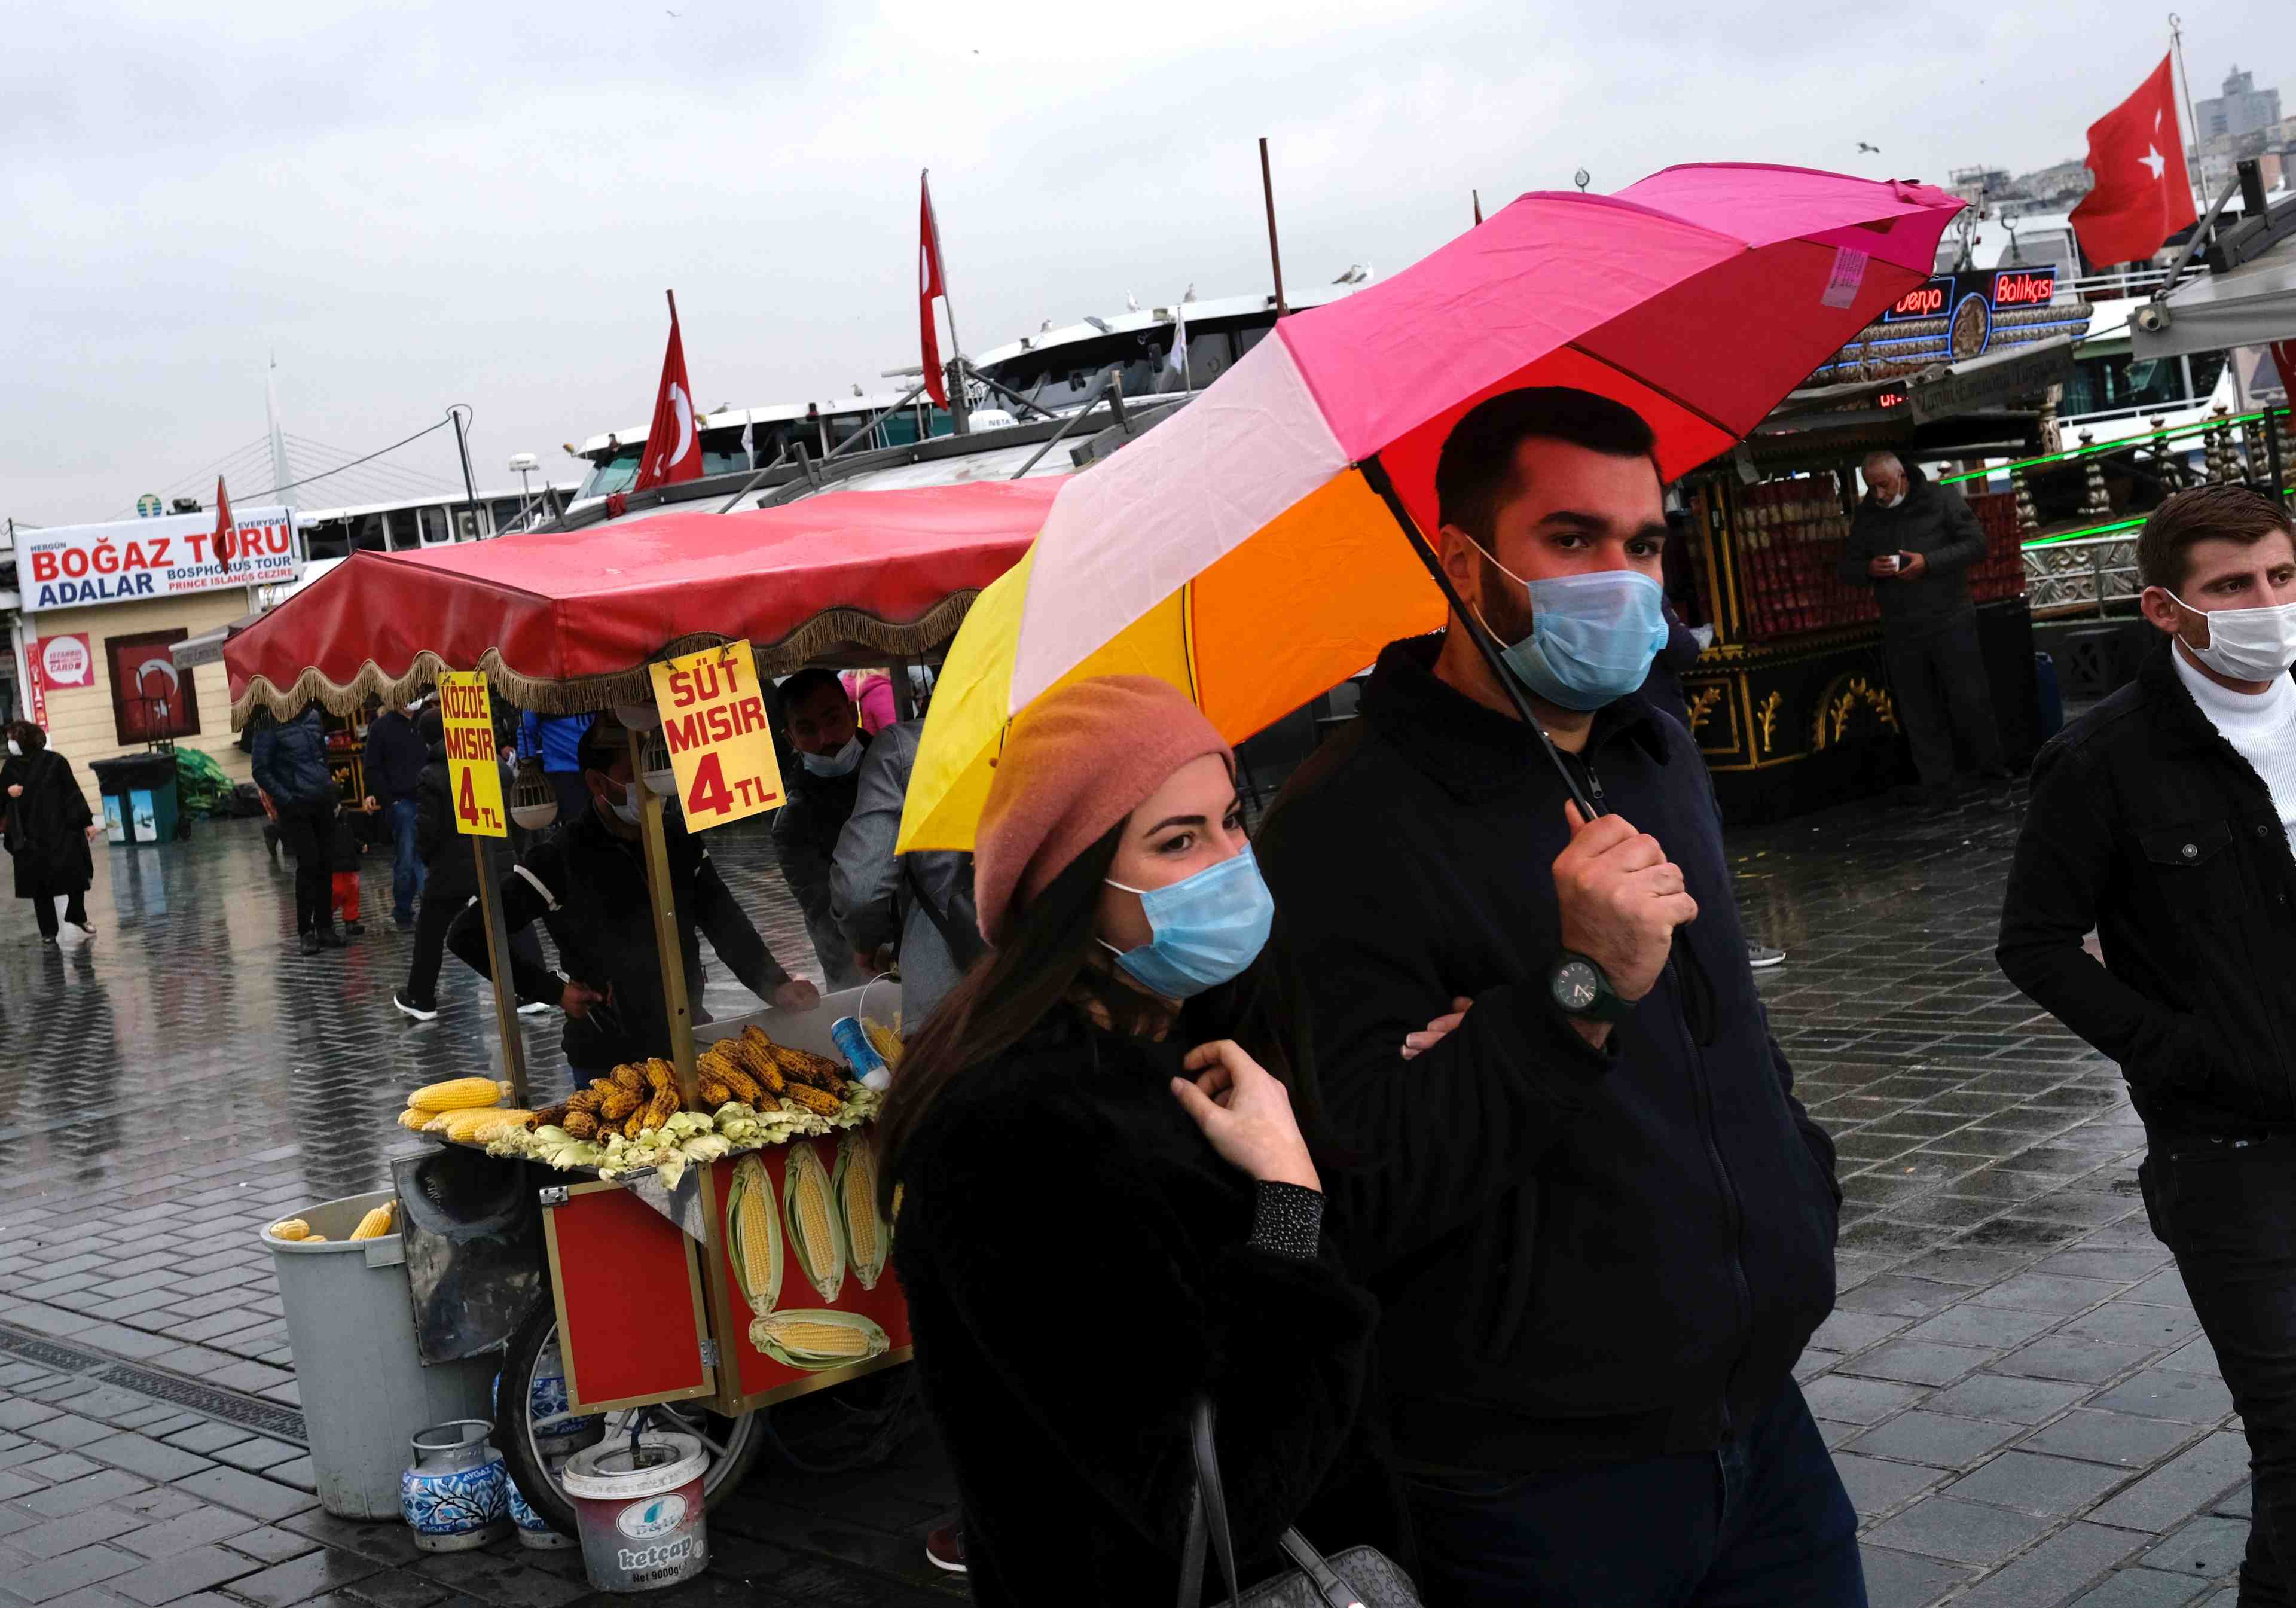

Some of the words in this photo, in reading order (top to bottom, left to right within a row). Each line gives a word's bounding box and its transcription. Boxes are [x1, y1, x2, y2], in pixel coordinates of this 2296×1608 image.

[1996, 274, 2053, 303] Balıkçısı
[237, 517, 286, 529] EVERYDAY
[30, 541, 66, 553] HERGÜN
[32, 536, 174, 582] BOĞAZ
[184, 524, 289, 563] TURU
[167, 560, 251, 580] BOSPHORUS
[255, 556, 292, 567] TOUR
[169, 578, 207, 591] PRINCE
[211, 572, 254, 585] ISLANDS
[38, 573, 154, 607] ADALAR
[668, 657, 738, 708] SÜT
[441, 681, 488, 719] KÖZDE
[664, 695, 766, 754] MISIR
[444, 727, 495, 761] MISIR
[459, 766, 480, 826] 4
[481, 807, 502, 829] TL
[687, 752, 735, 816] 4
[734, 776, 777, 807] TL
[462, 1466, 492, 1482] AYGAZ
[618, 1536, 692, 1569] ketçap
